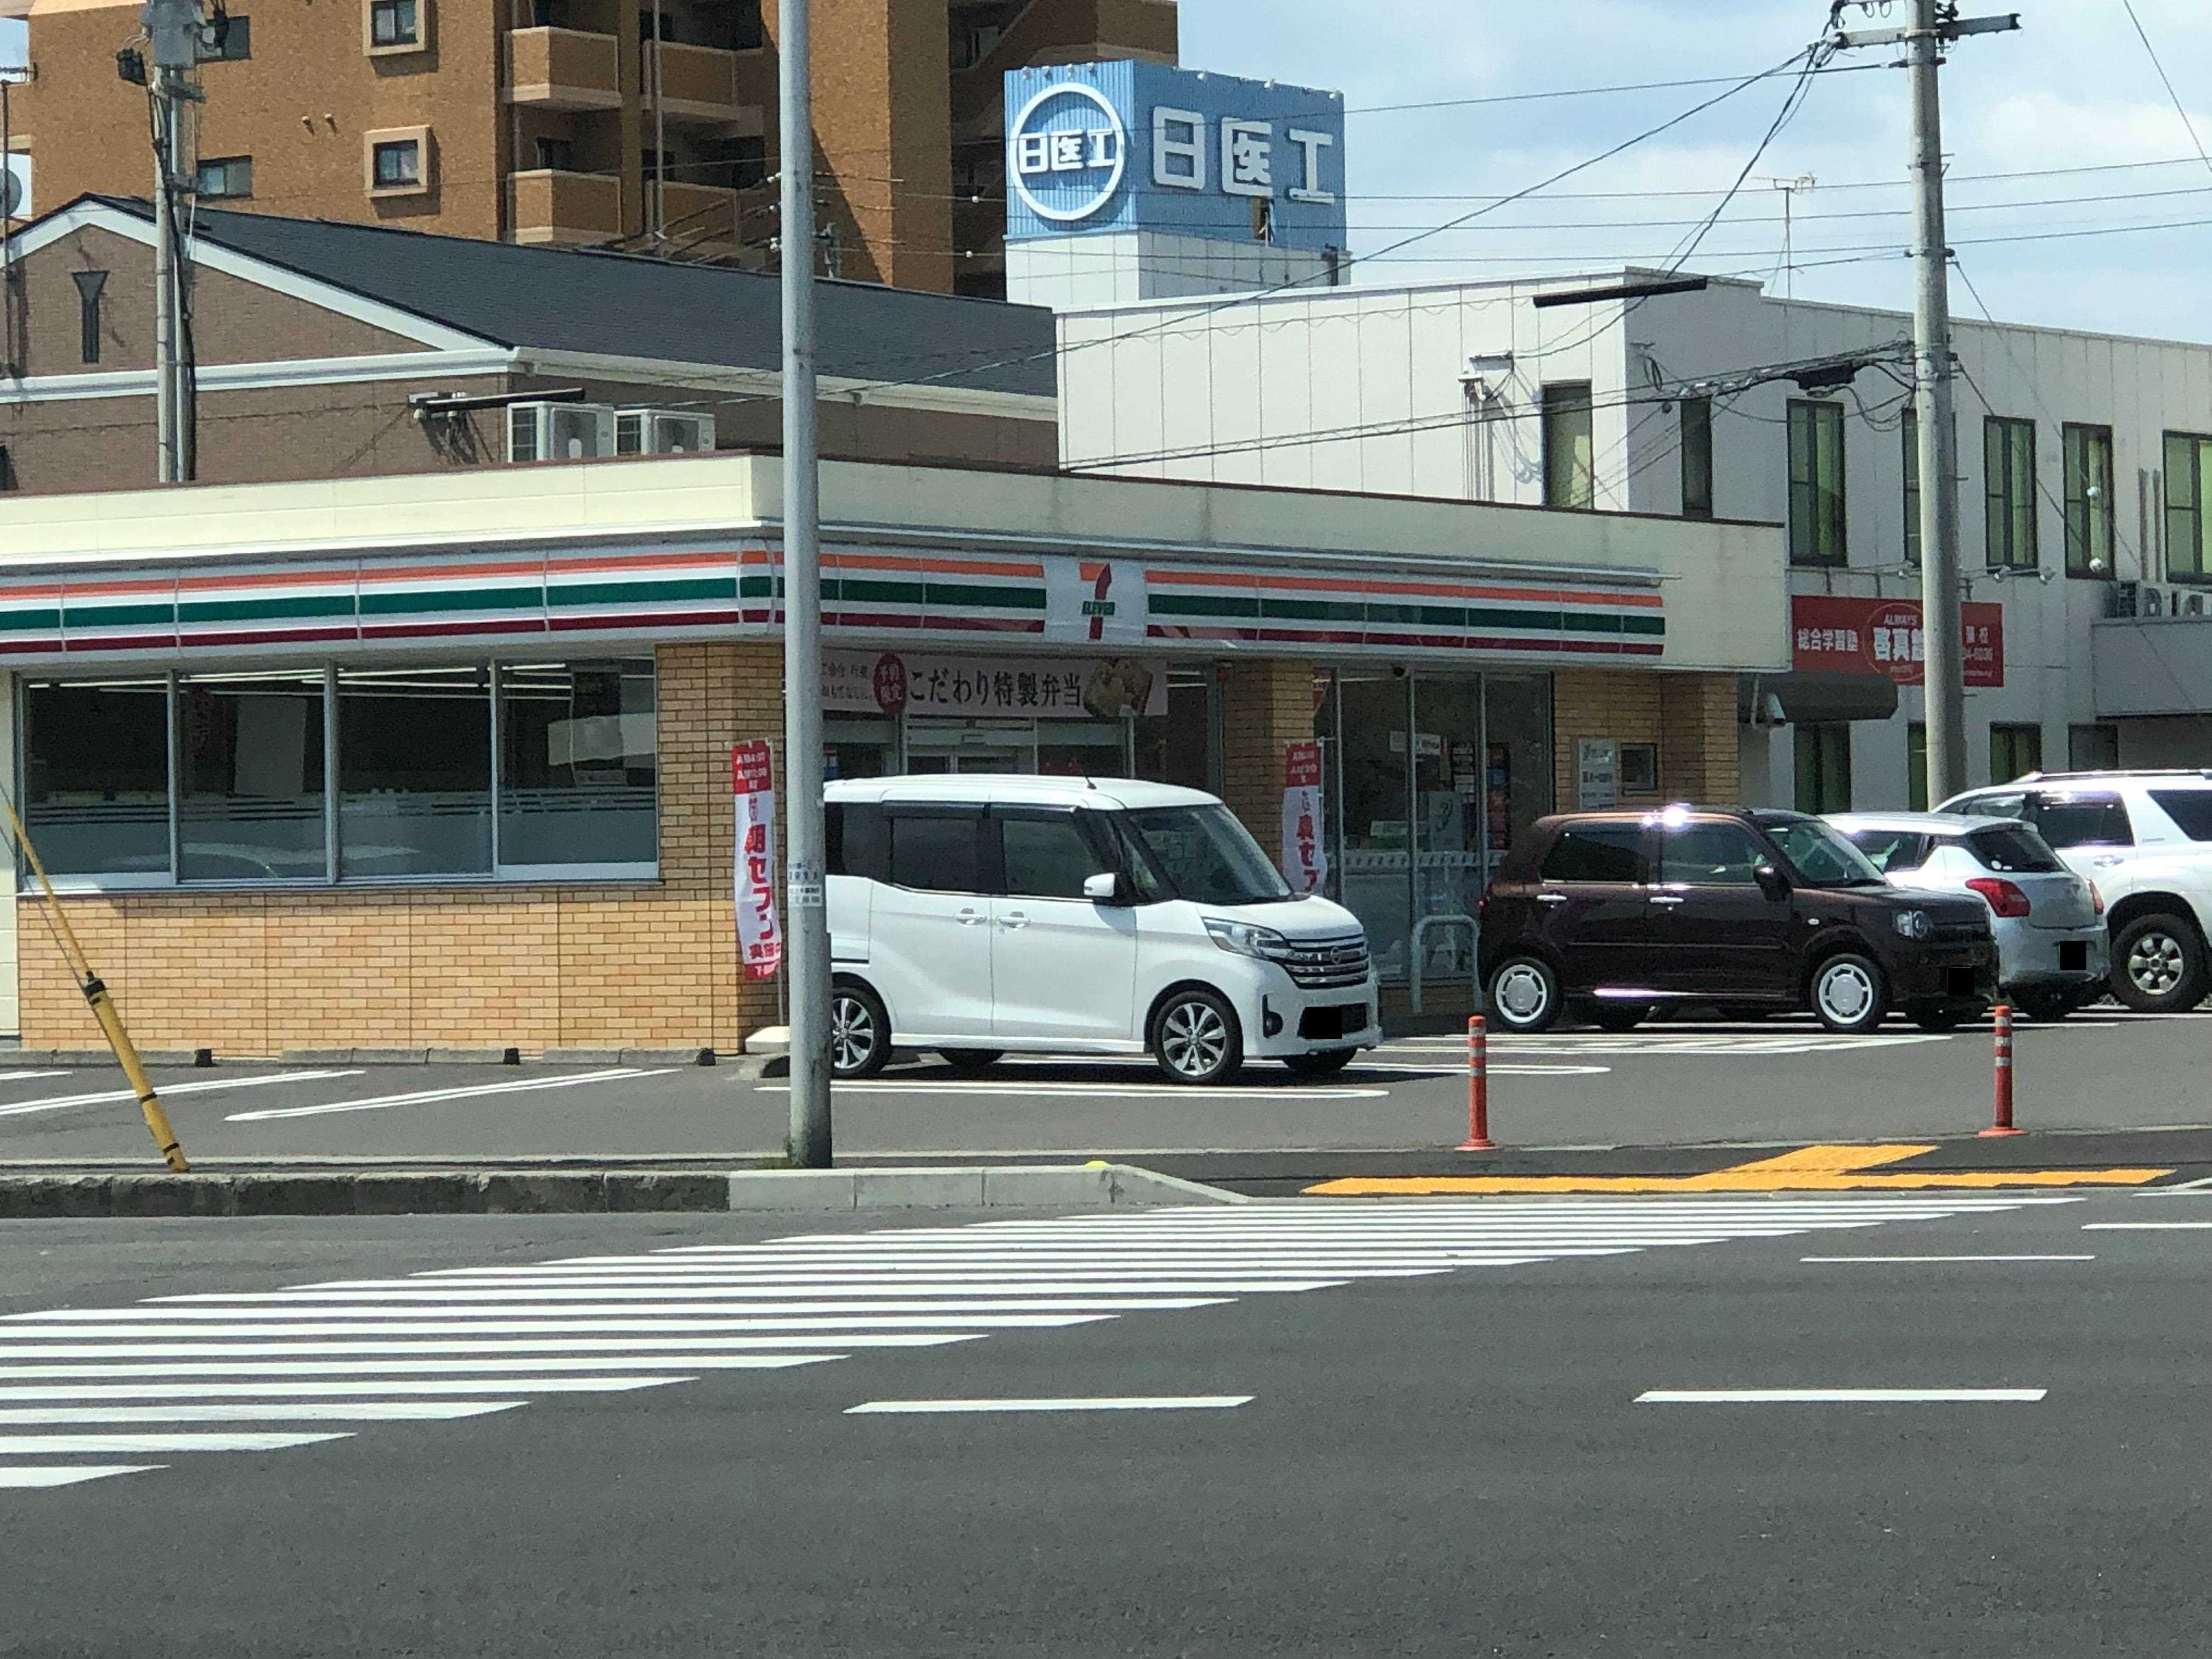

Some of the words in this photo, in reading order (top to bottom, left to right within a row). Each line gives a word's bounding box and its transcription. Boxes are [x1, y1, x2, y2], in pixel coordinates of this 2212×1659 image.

[1019, 129, 1116, 173] 日医工
[1153, 105, 1334, 206] 日医工
[910, 667, 1081, 707] こだわり特製弁当
